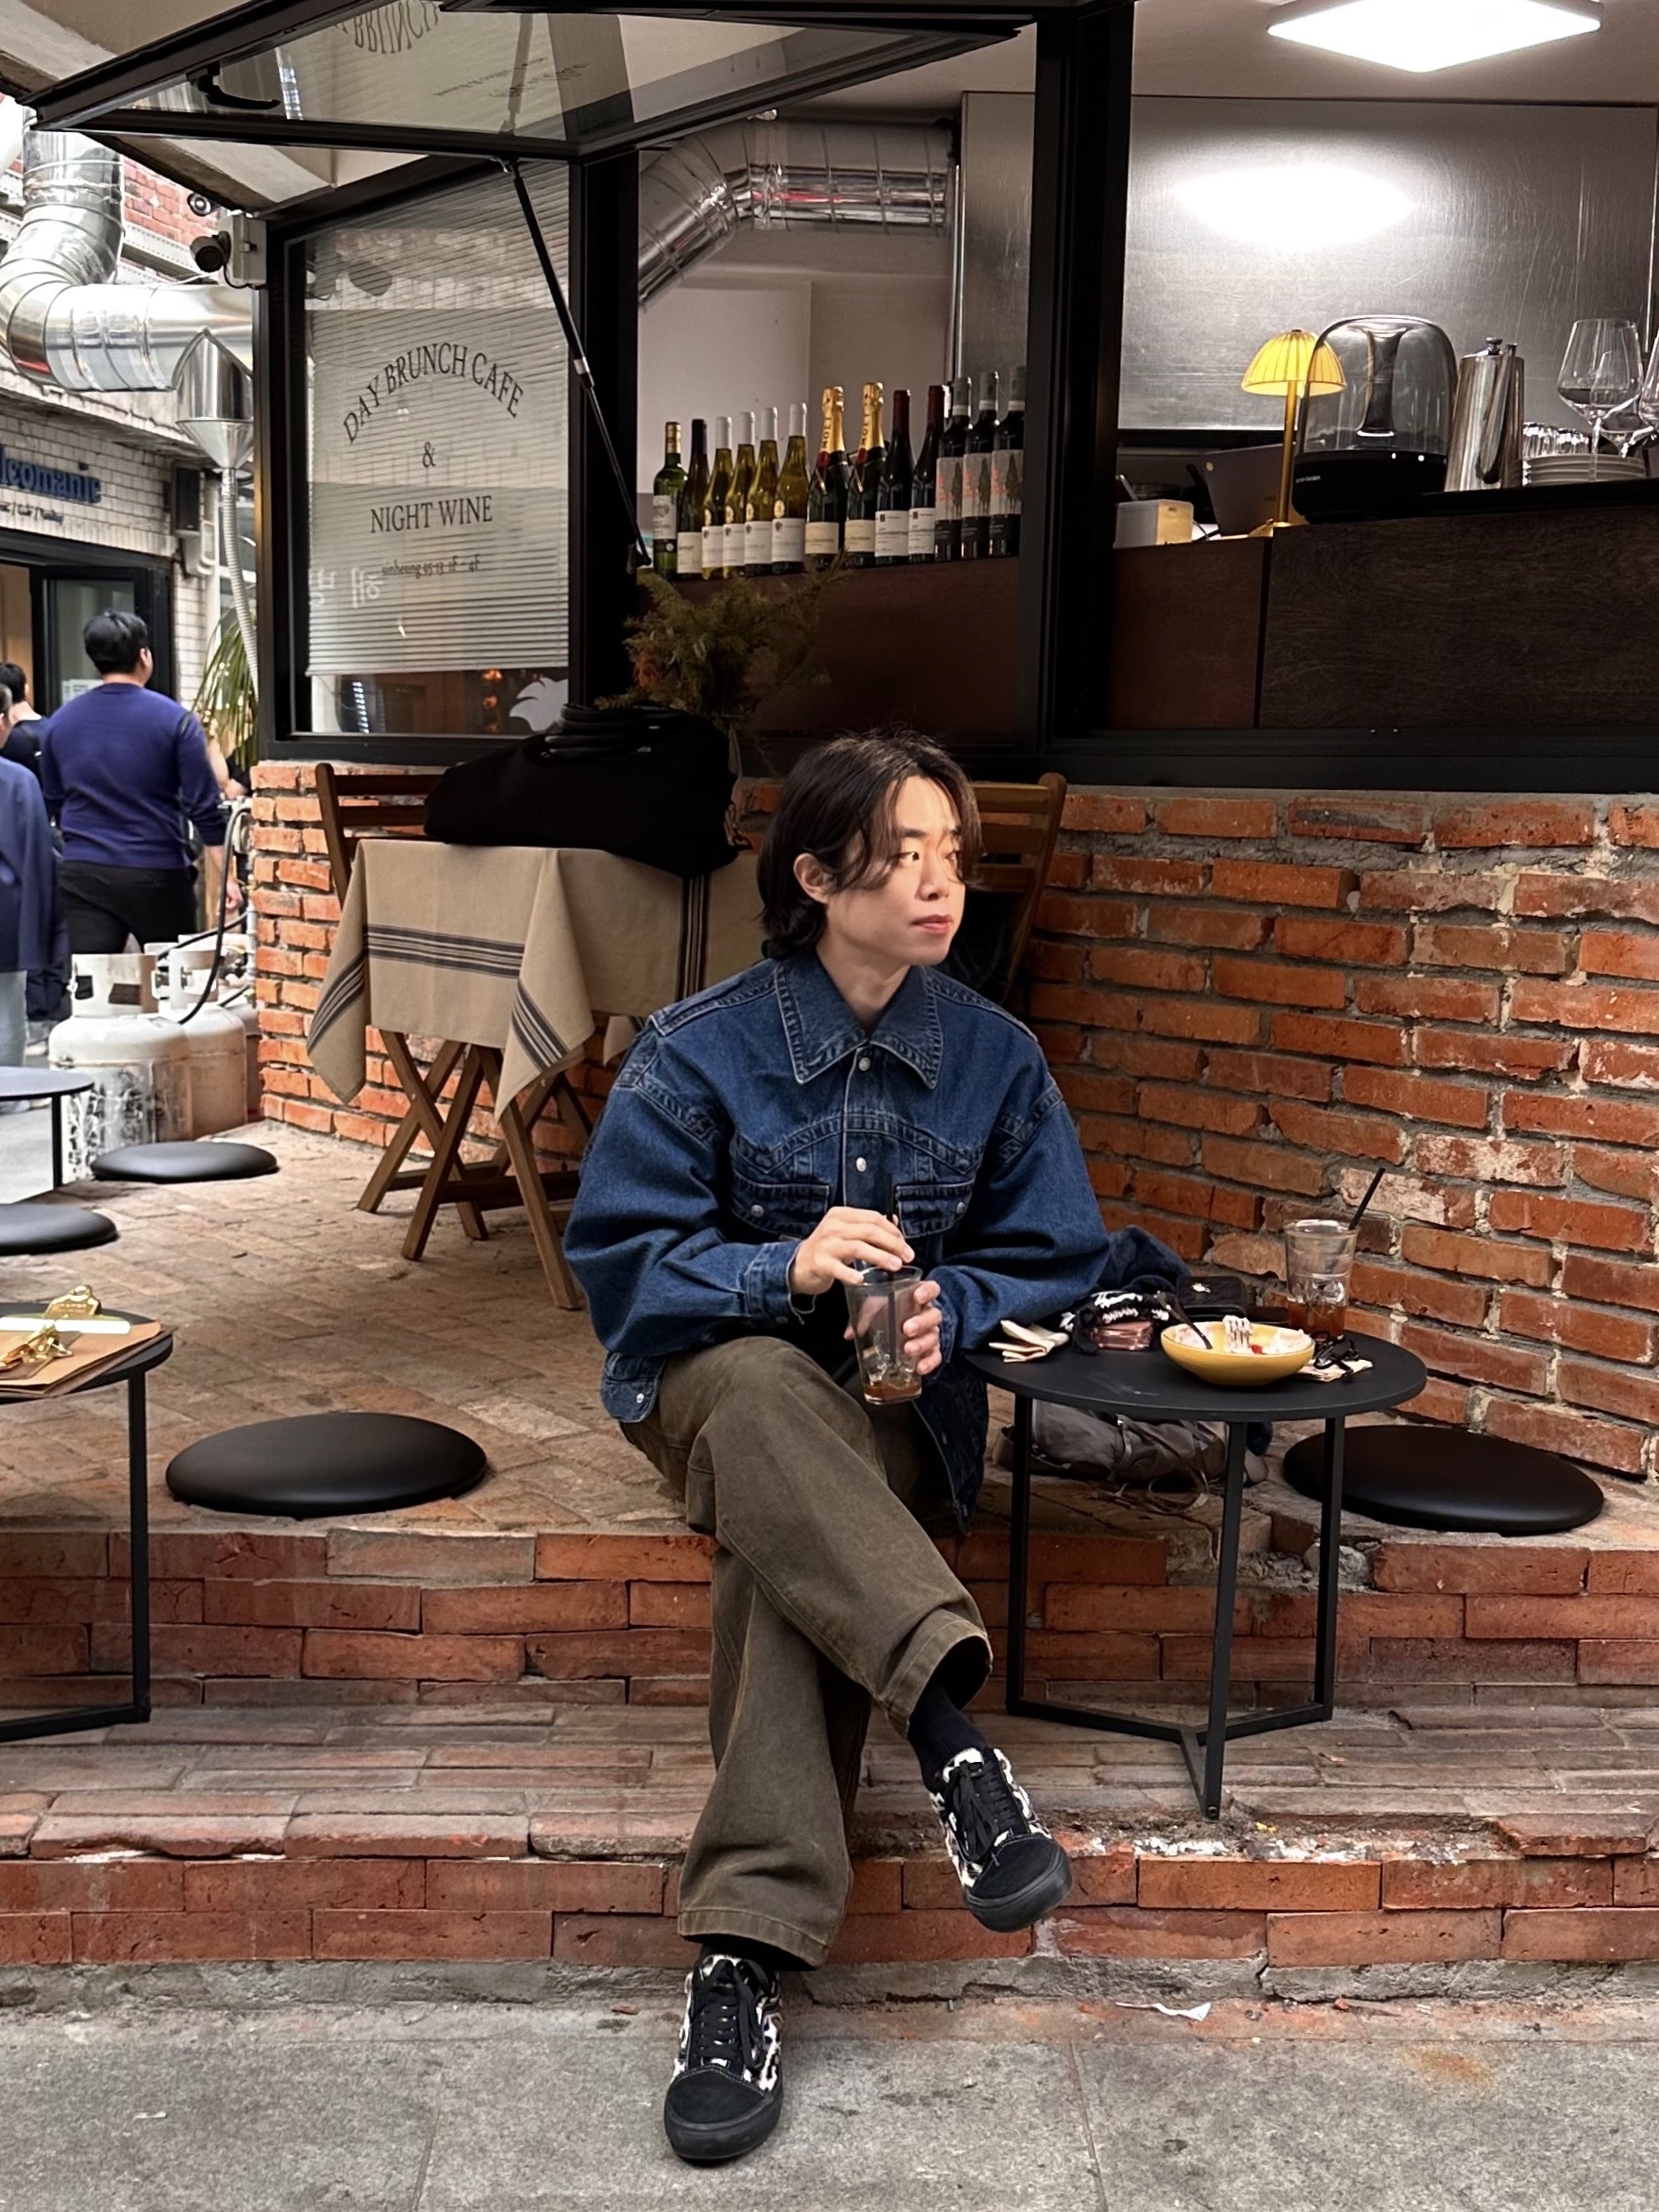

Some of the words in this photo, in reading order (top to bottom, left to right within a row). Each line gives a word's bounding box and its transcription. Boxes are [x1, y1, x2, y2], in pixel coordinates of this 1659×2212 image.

[343, 375, 382, 444] DAY
[384, 343, 469, 394] BRUNCH
[471, 352, 524, 419] CAFE
[422, 442, 436, 468] &
[370, 501, 434, 533] NIGHT
[437, 495, 493, 526] WINE
